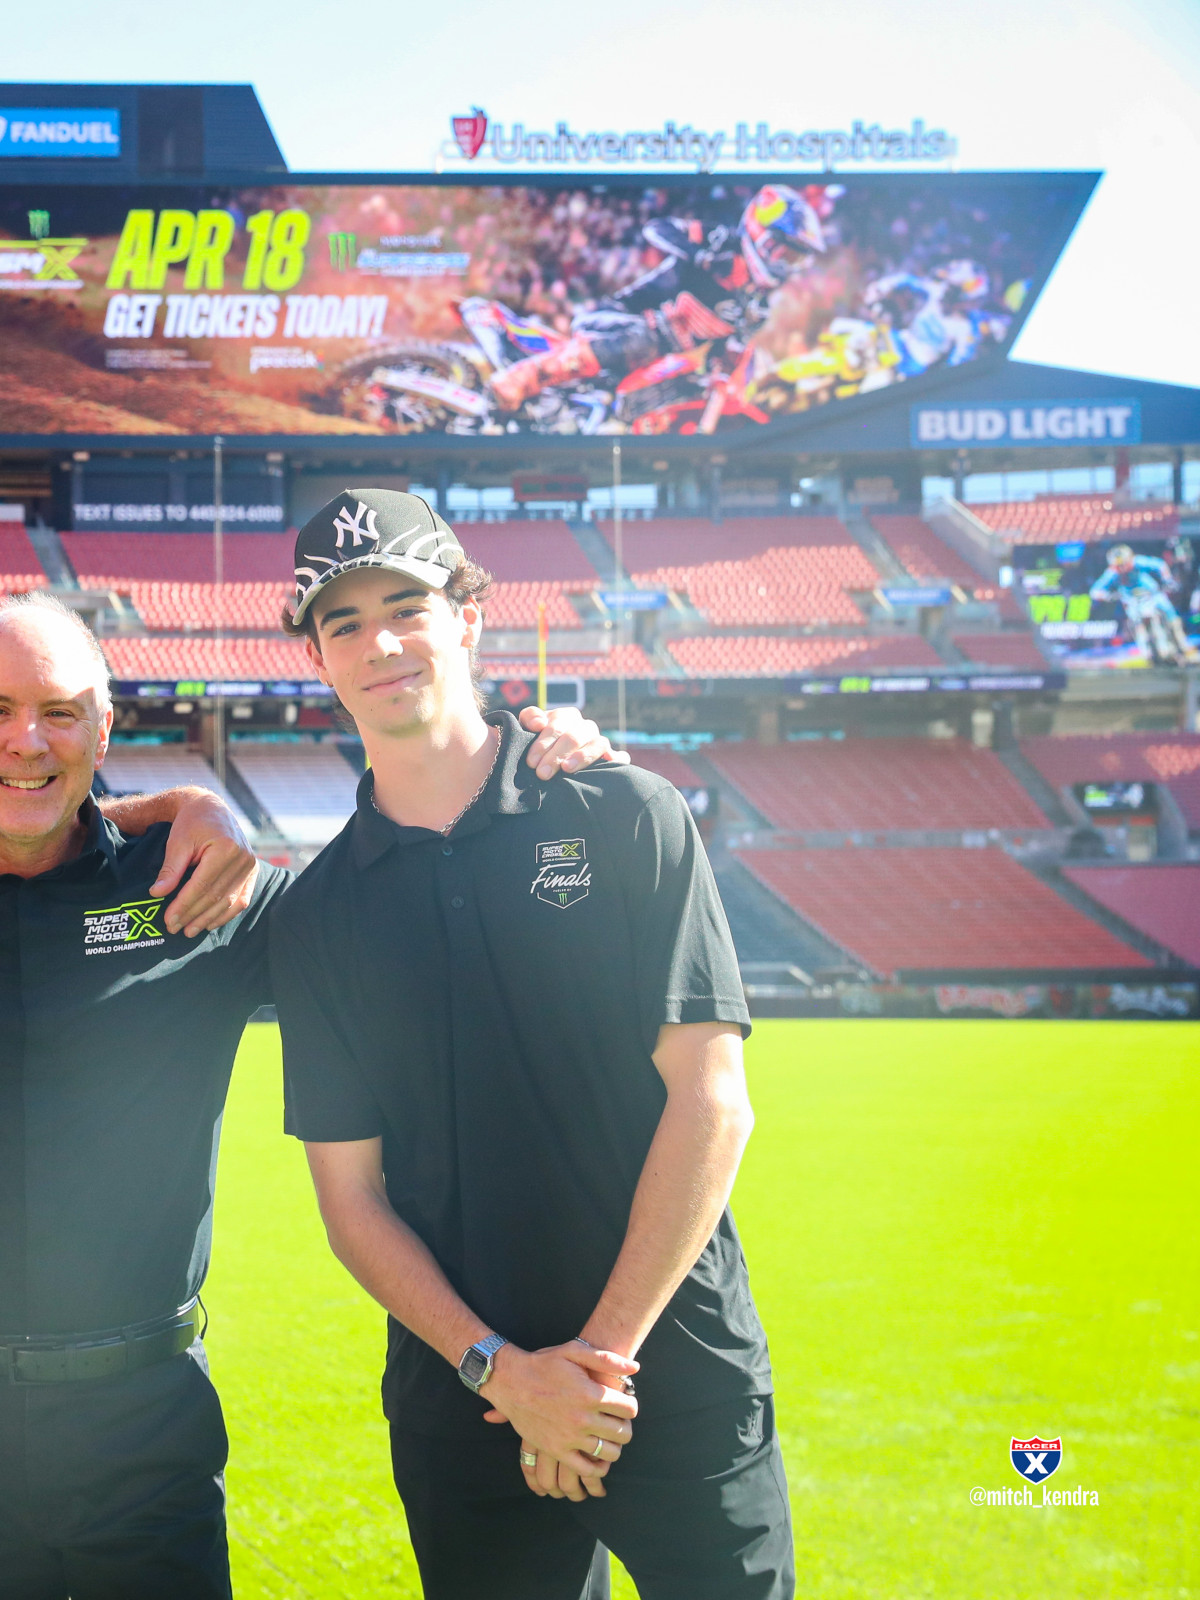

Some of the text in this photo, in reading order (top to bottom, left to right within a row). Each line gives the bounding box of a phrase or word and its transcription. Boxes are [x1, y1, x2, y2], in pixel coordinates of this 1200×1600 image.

[9, 121, 119, 143] FANDUEL
[493, 122, 725, 173] University
[735, 119, 949, 173] Hospitals
[105, 208, 312, 291] APR 18
[103, 294, 388, 338] GET TICKETS TODAY!
[918, 406, 1132, 441] BUD LIGHT
[74, 504, 111, 521] TEXT
[113, 504, 163, 521] ISSUES
[165, 504, 187, 521] TO
[530, 863, 592, 894] Finals
[83, 913, 130, 926] SUPER
[87, 922, 128, 935] MOTO
[84, 930, 130, 944] CROSS
[85, 938, 165, 956] WORLD CHAMPIONSHIP
